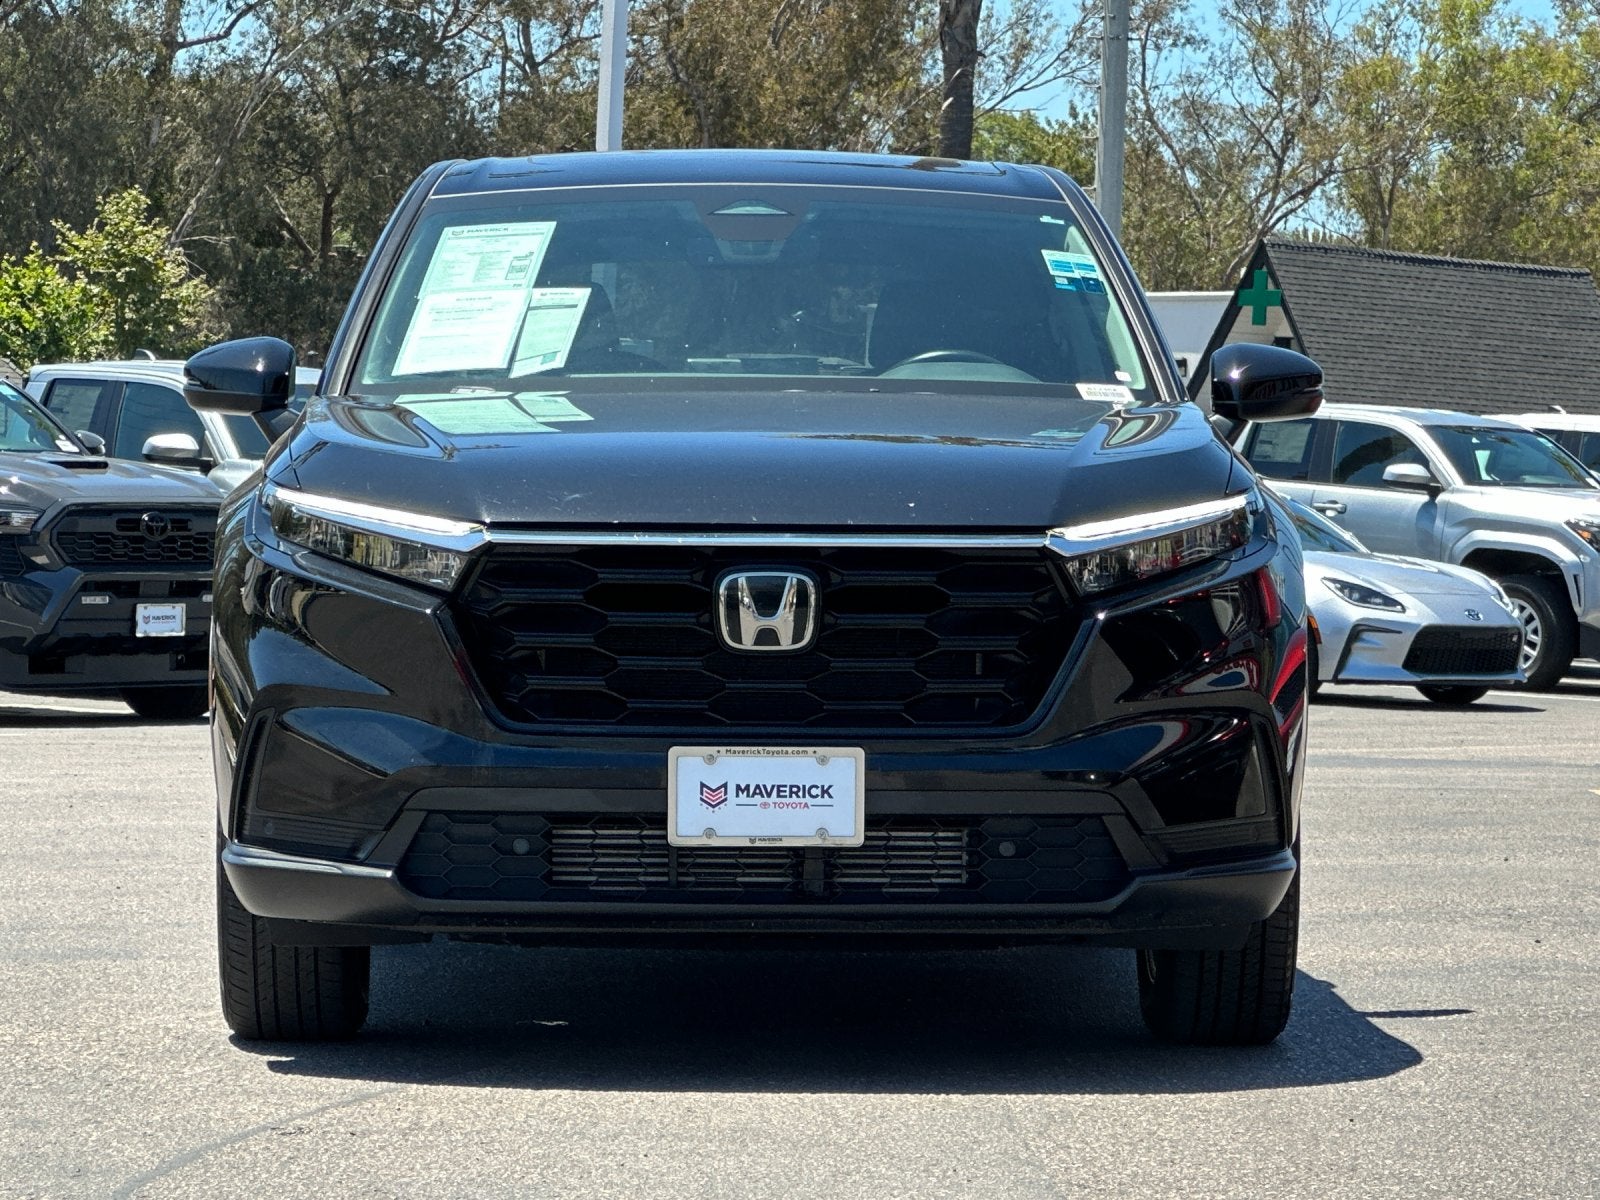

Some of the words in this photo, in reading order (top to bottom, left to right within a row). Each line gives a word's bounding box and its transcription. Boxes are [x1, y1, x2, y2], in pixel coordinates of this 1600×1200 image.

[725, 748, 809, 756] MaverickToyota.com
[735, 783, 834, 799] MAVERICK
[771, 801, 810, 810] TOYOTA
